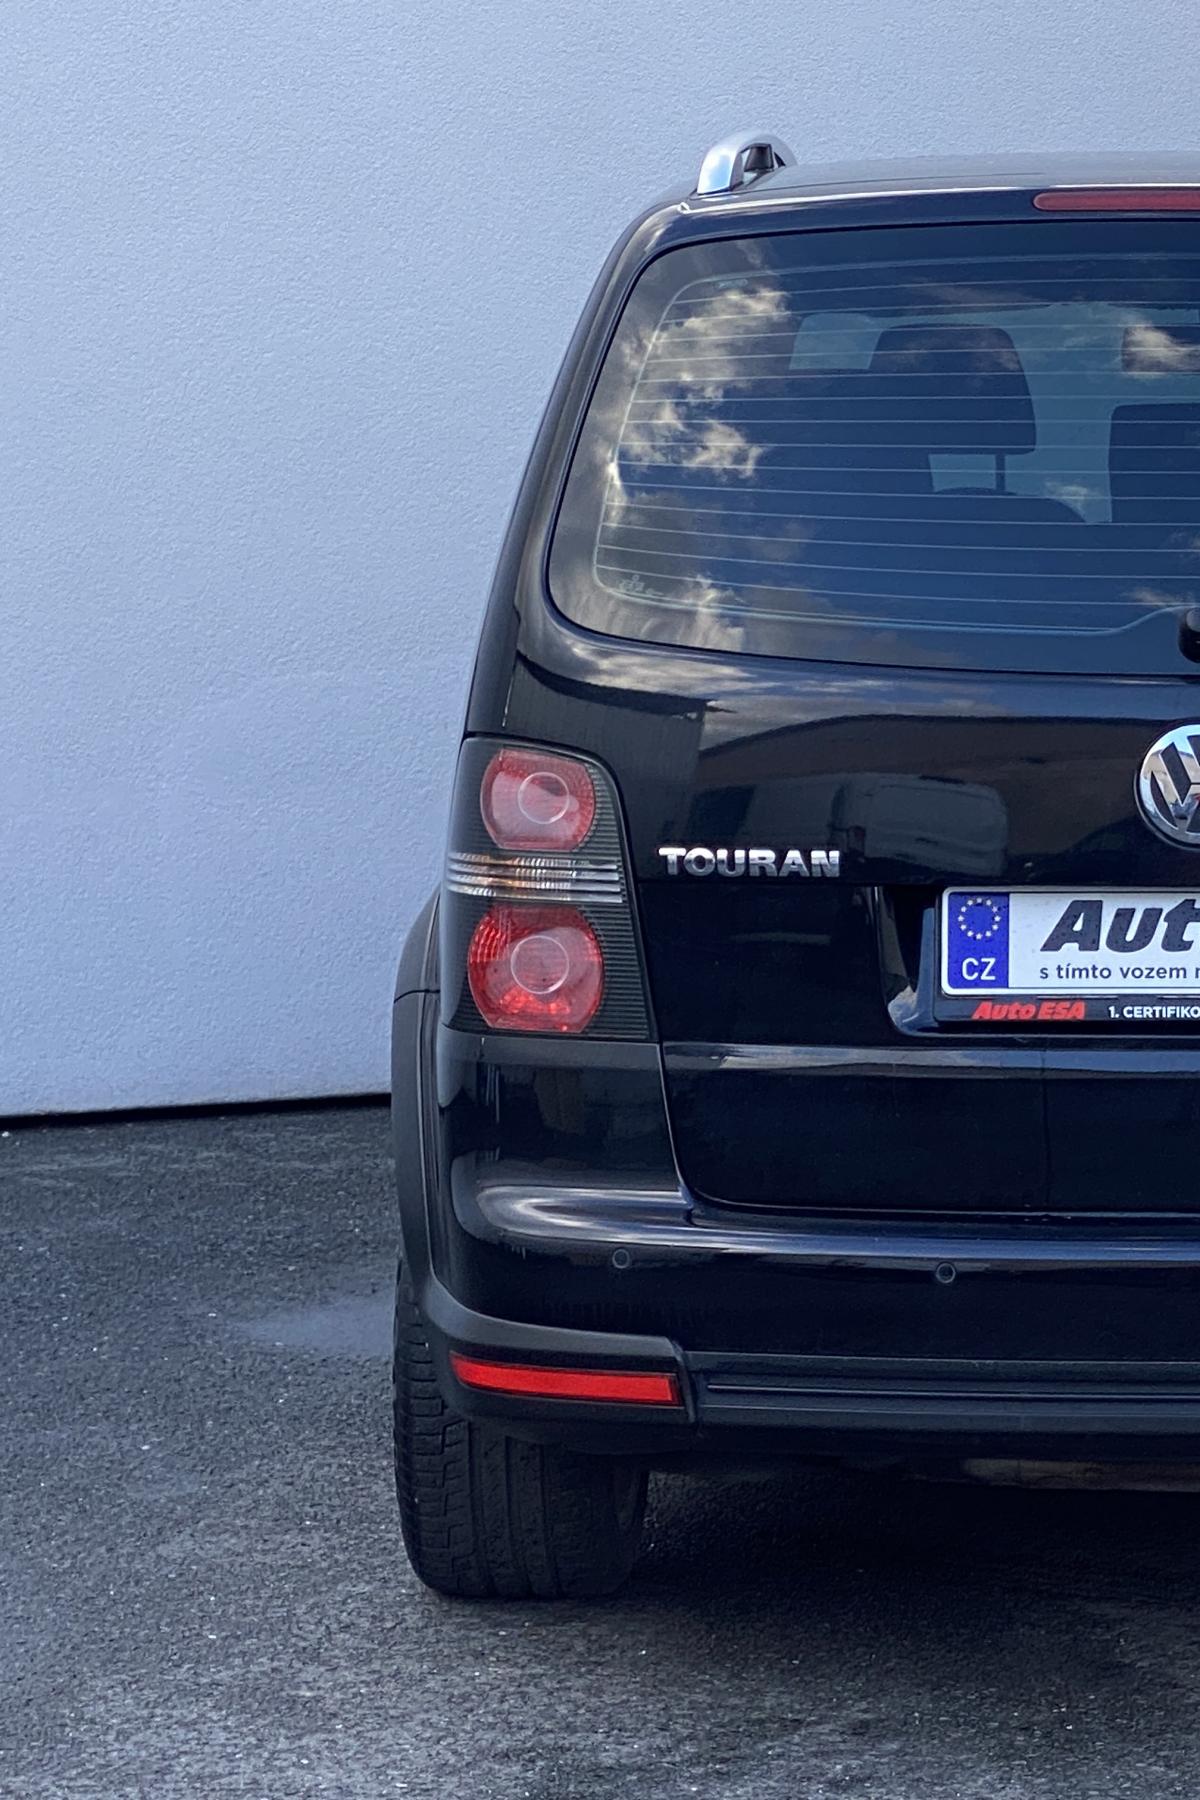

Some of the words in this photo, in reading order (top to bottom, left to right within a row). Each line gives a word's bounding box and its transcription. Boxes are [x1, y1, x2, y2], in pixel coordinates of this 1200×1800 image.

[658, 846, 841, 879] TOURAN
[962, 957, 996, 981] CZ
[1040, 967, 1049, 979] s
[1056, 963, 1112, 980] tímto
[1120, 967, 1187, 980] vozem
[971, 1001, 1037, 1020] Auto
[1037, 1001, 1086, 1020] ESA
[1108, 1006, 1119, 1018] 1.
